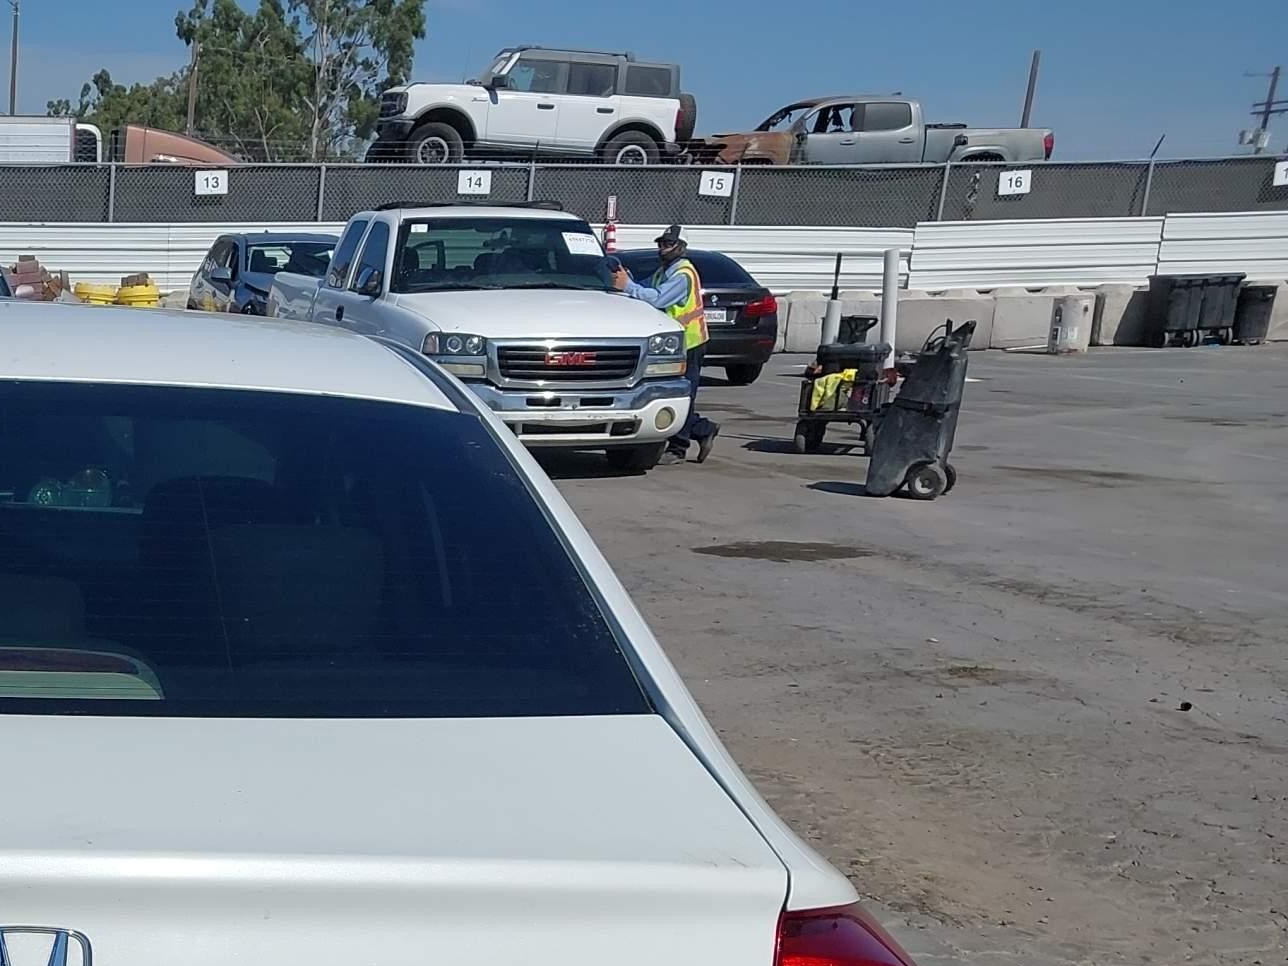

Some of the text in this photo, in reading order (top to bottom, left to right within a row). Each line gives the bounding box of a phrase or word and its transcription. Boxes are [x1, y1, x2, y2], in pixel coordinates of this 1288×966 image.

[204, 176, 220, 189] 13
[466, 176, 482, 188] 14
[708, 177, 724, 190] 15
[1008, 176, 1023, 188] 16
[543, 351, 597, 366] GMC
